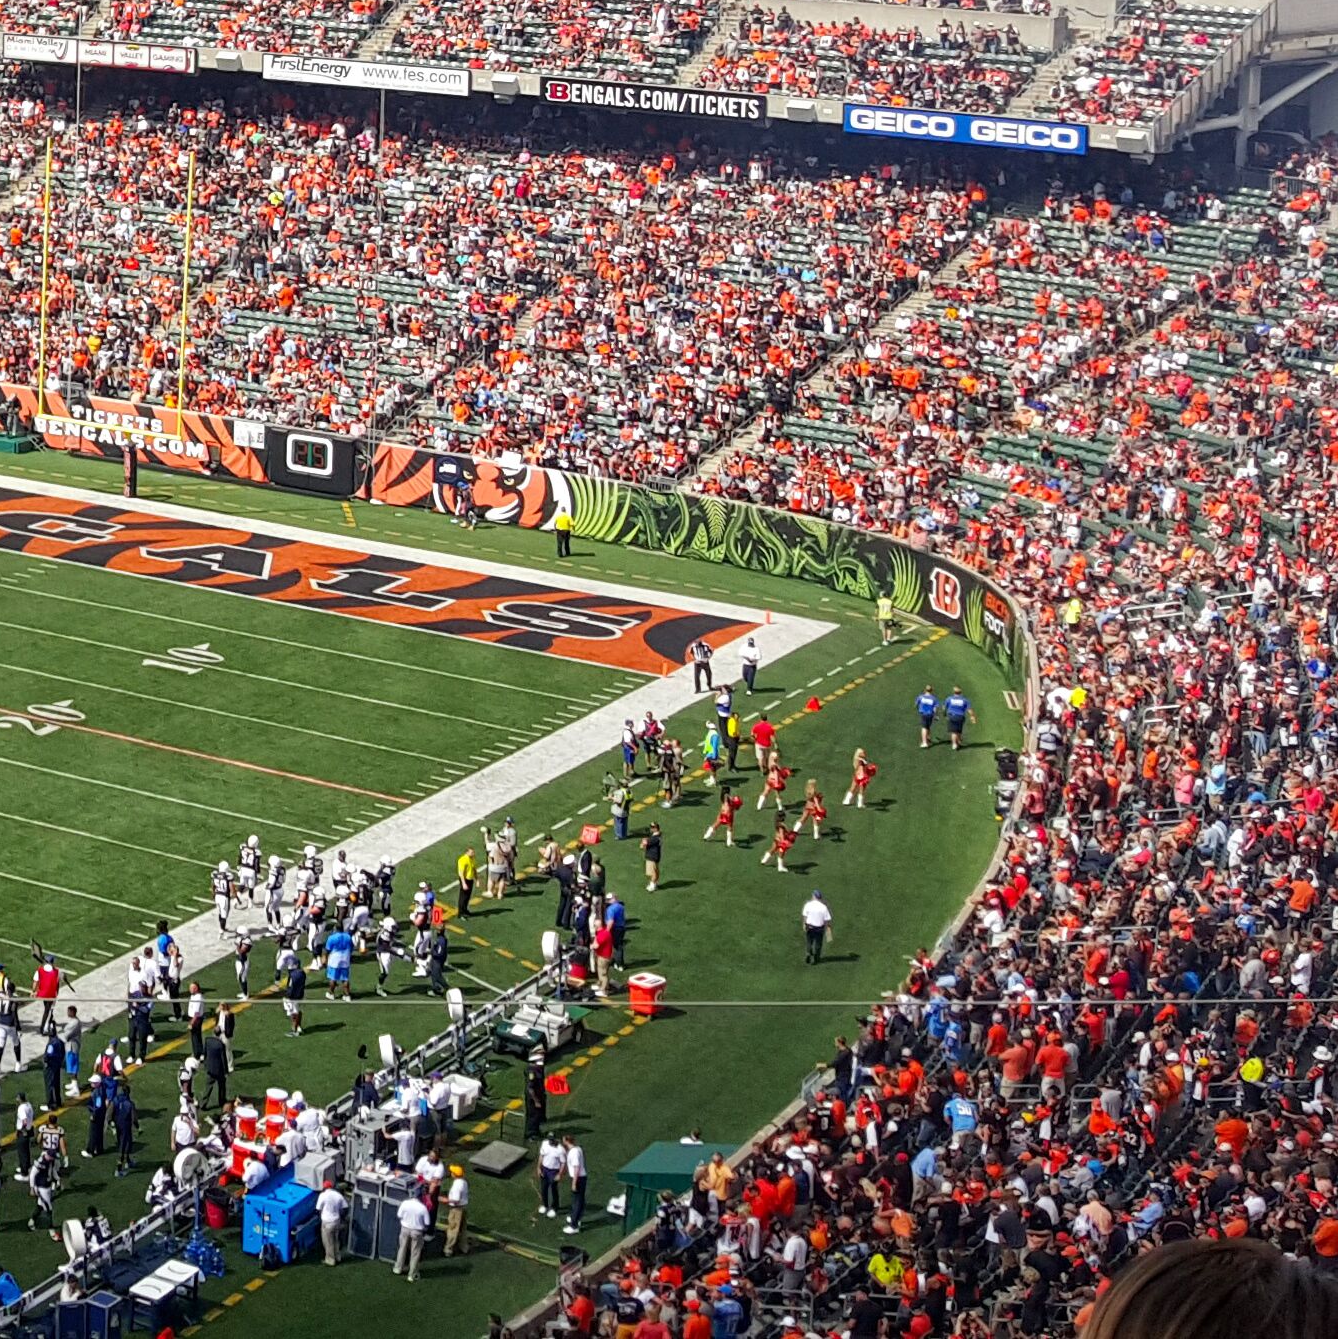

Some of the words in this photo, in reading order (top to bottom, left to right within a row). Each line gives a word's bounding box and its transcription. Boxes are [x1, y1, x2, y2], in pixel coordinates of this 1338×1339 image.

[6, 36, 34, 45] Miami
[36, 37, 64, 50] Valley
[84, 49, 107, 57] MIAMI
[120, 51, 143, 60] VALLEY
[152, 54, 183, 63] GAMING
[271, 55, 351, 78] FirstEnergy
[362, 65, 462, 85] www.fes.com
[545, 80, 760, 120] BENGALS.COM/TICKETS
[849, 109, 955, 138] GEICO
[970, 119, 1079, 150] GEICO
[72, 404, 163, 434] TICKETS
[34, 417, 207, 460] BENGALS.COM
[141, 647, 225, 676] 10
